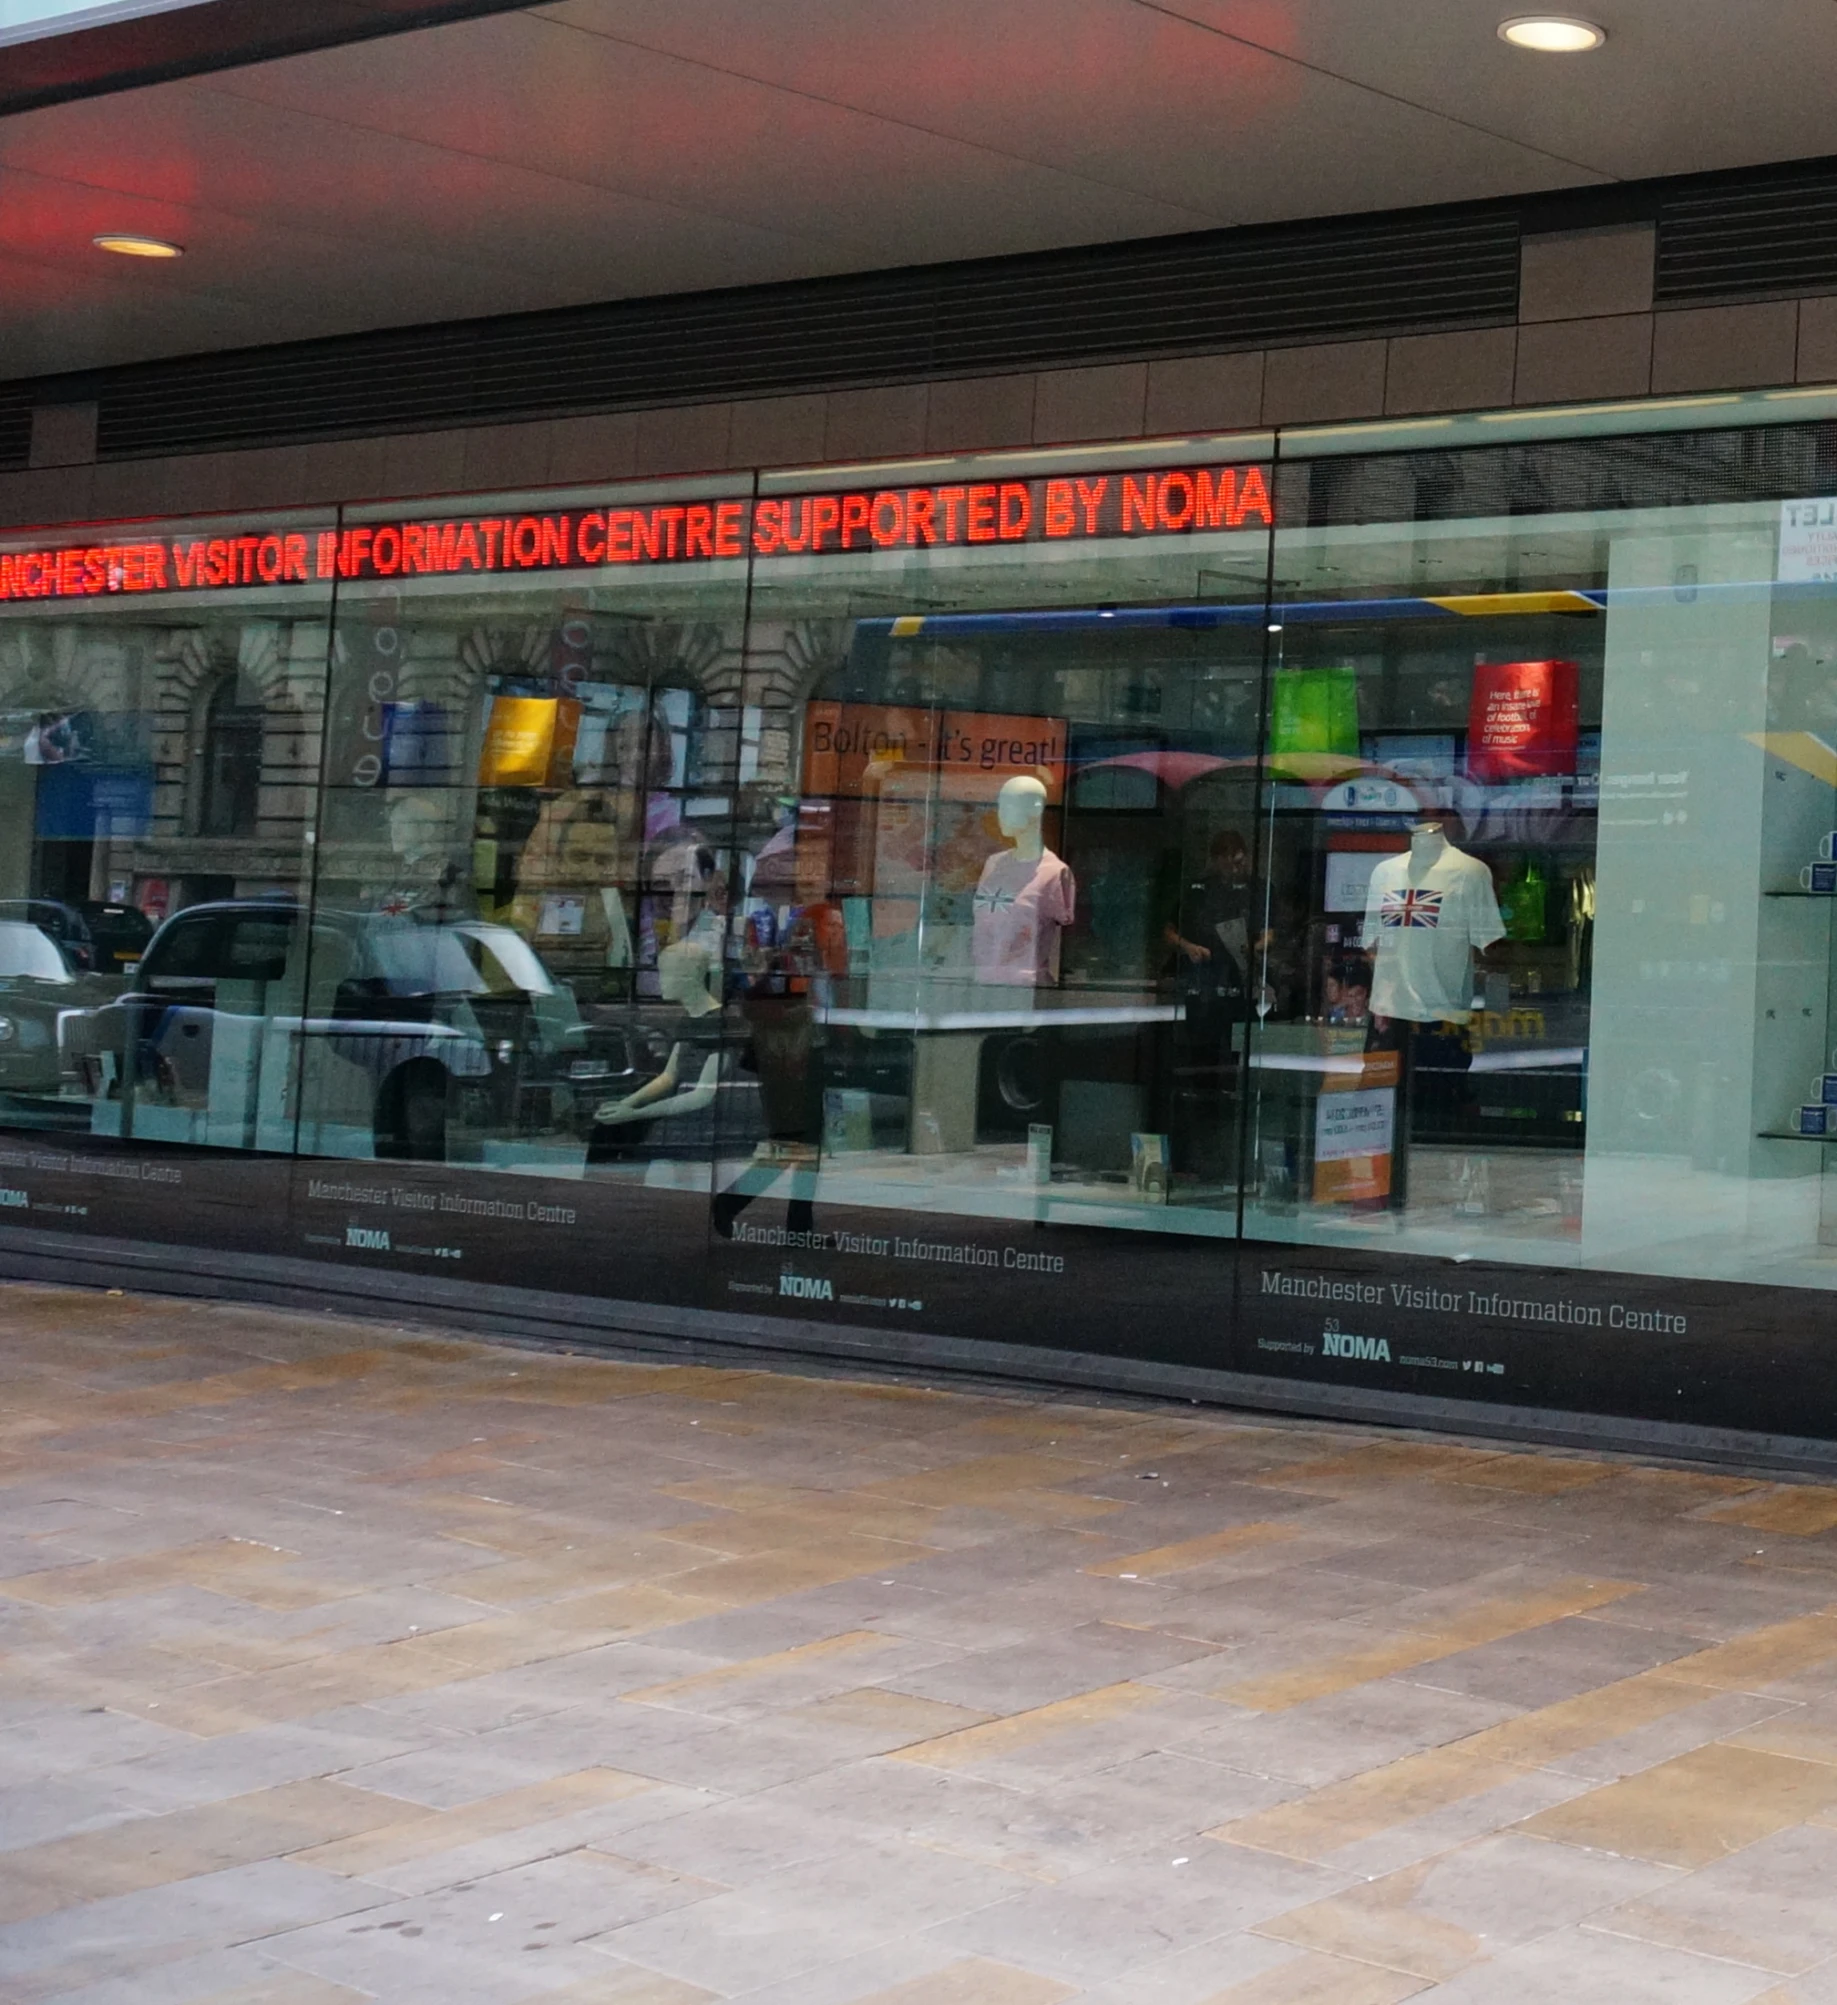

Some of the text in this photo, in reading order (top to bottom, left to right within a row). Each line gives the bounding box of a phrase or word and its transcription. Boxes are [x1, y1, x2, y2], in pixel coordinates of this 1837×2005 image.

[172, 533, 307, 587] VISITOR
[317, 514, 570, 578] INFORMATION
[577, 503, 742, 562] CENTRE
[752, 482, 1031, 554] SUPPORTED
[1045, 477, 1109, 538] BY
[1122, 466, 1272, 532] NOMA
[813, 720, 907, 756] Bolton
[980, 736, 1057, 770] great!
[1492, 733, 1519, 744] music
[0, 1188, 29, 1209] OMA
[308, 1179, 577, 1225] Manchester Visitor Information Centre
[345, 1227, 391, 1251] NOMA
[731, 1220, 1065, 1273] Manchester Visitor Information Centre
[779, 1275, 834, 1301] NOMA
[1260, 1270, 1687, 1334] Manchester Visitor Information Centre
[1324, 1317, 1340, 1332] 53
[1257, 1331, 1459, 1371] Supported by NOMA noma53.com
